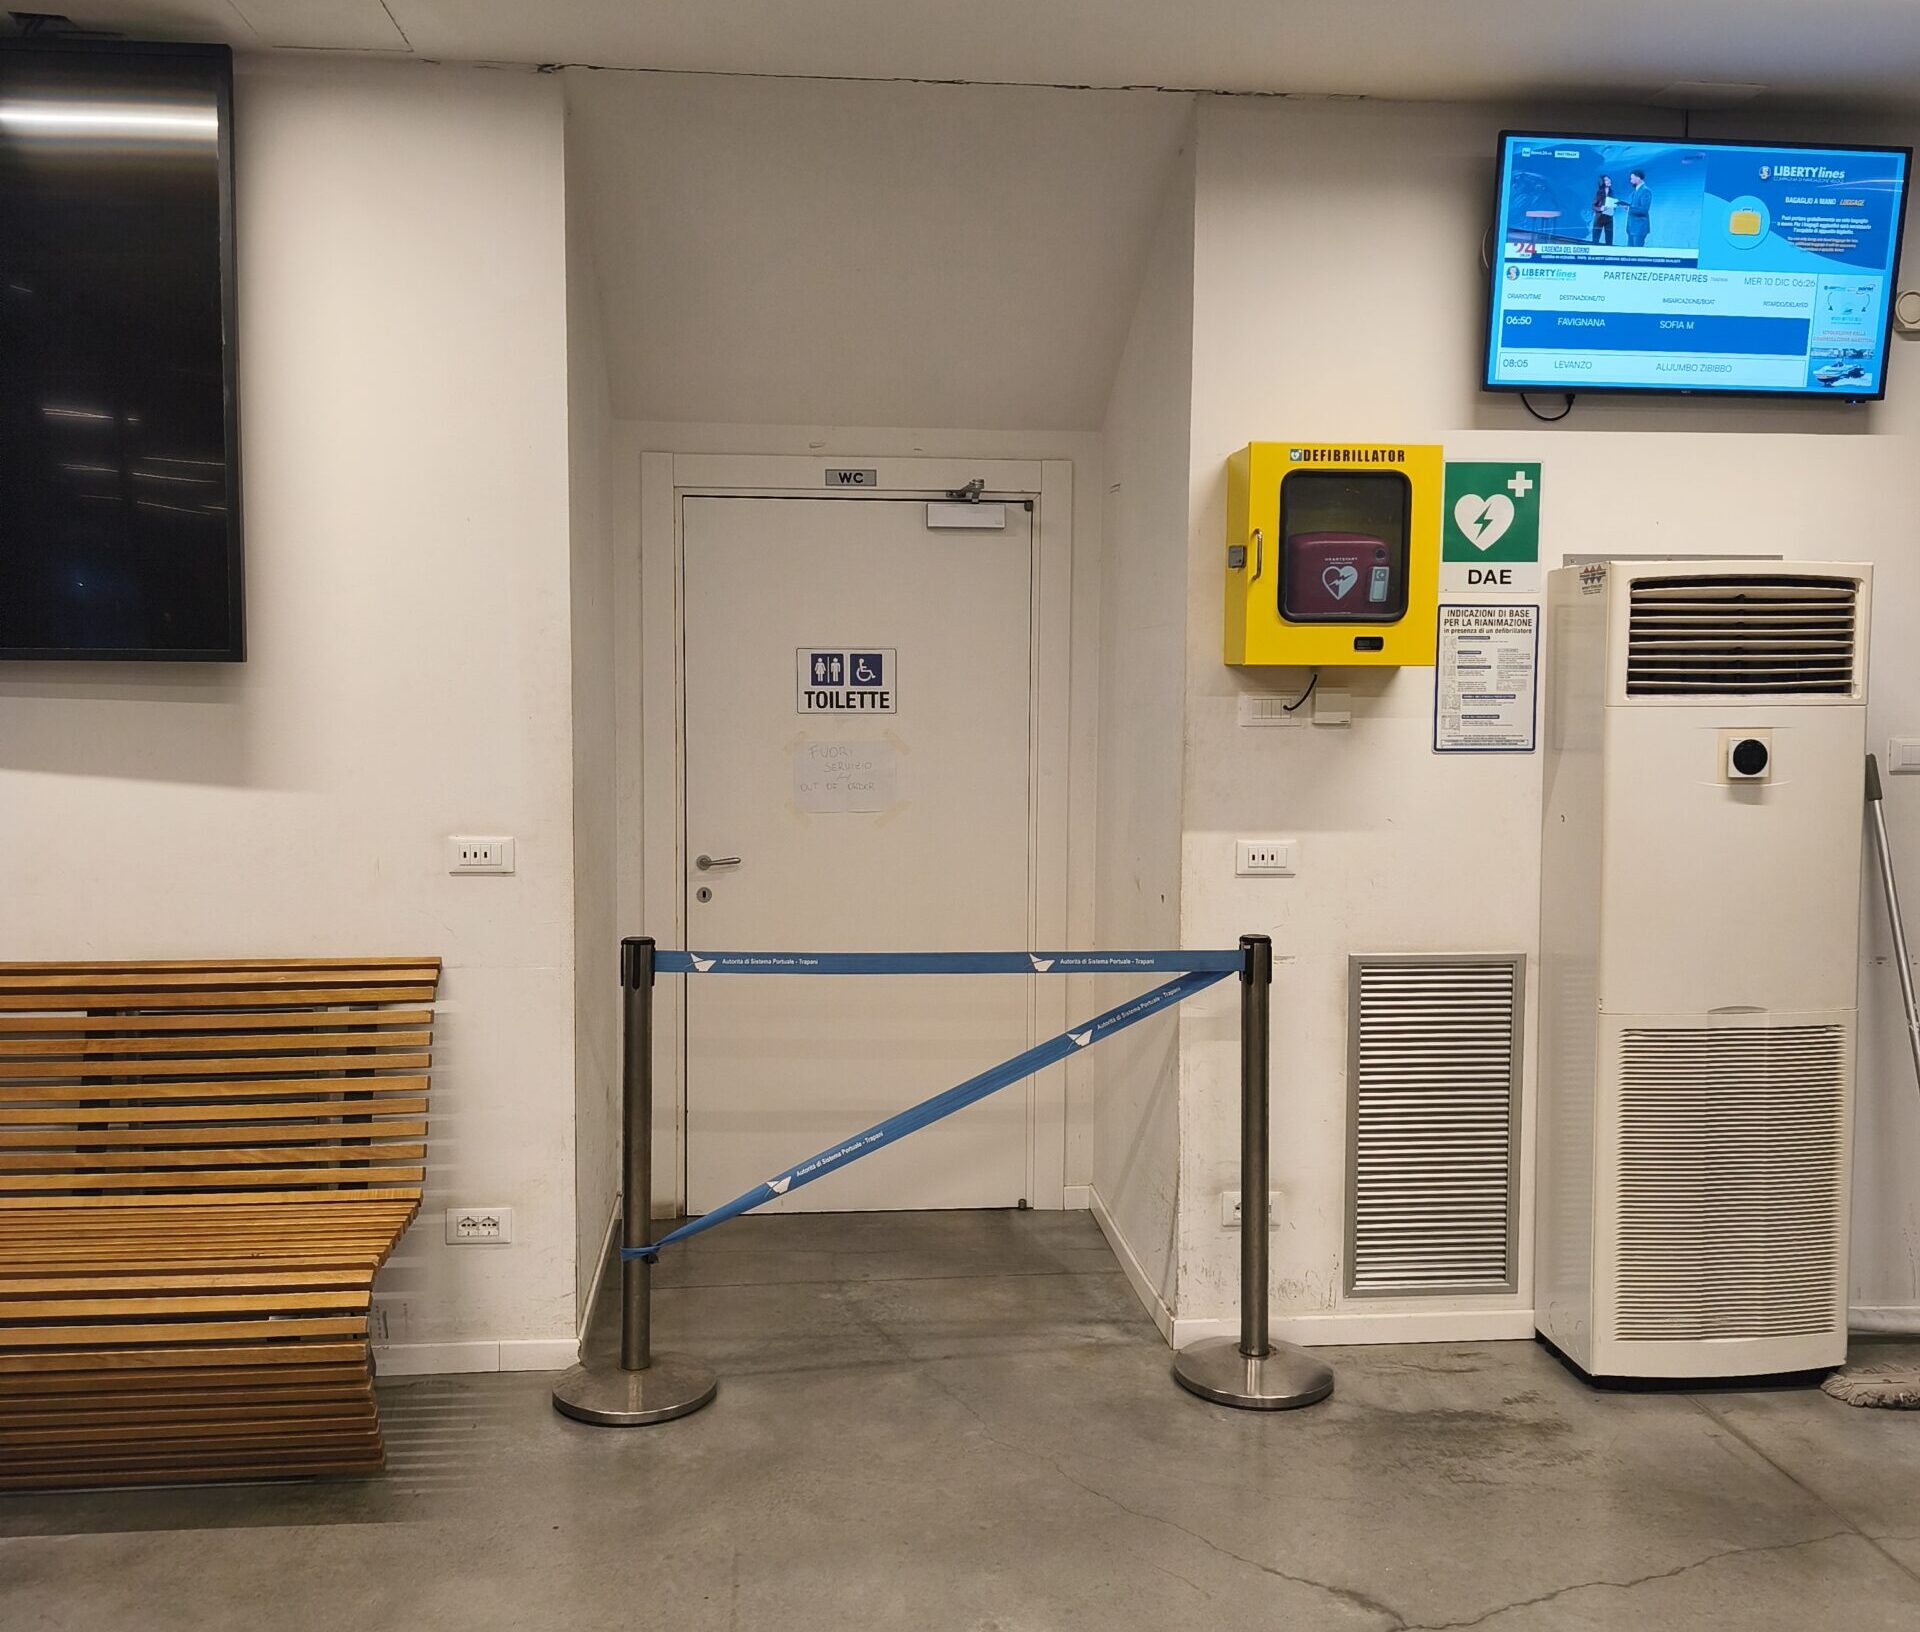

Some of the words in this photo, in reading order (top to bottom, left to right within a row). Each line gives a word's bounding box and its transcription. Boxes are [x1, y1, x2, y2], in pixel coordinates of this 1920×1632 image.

[1603, 271, 1708, 284] PARTENZE/DEPARTURES
[1744, 277, 1762, 286] MER
[1764, 278, 1773, 286] 10
[1775, 278, 1790, 287] DIC
[1792, 279, 1816, 288] 06:26
[1506, 316, 1532, 325] 06:50
[1557, 317, 1606, 327] FAVIGNANA
[1659, 320, 1685, 329] SOFIA
[1686, 321, 1694, 330] M
[1502, 359, 1529, 368] 08:05
[1554, 360, 1593, 370] LEVANZO
[1699, 363, 1733, 373] ZIBIBBO
[1302, 448, 1406, 463] DEFIBRILLATOR
[837, 471, 865, 484] WC
[1466, 569, 1513, 585] DAE
[1447, 609, 1496, 618] INDICAZIONI
[1498, 609, 1507, 618] DI
[1509, 609, 1530, 618] BASE
[1443, 618, 1460, 627] PER
[1462, 618, 1472, 627] LA
[1474, 618, 1533, 627] RIANIMAZIONE
[803, 690, 891, 710] TOILETTE
[799, 782, 819, 793] OUT
[826, 782, 839, 791] OF
[847, 782, 875, 791] ORDER
[799, 958, 818, 966] Trapani
[1135, 957, 1155, 966] Trapani
[1121, 1006, 1141, 1018] Sistema
[1140, 996, 1160, 1009] Portuale
[821, 1151, 842, 1165] Sistema
[841, 1141, 862, 1156] Portuale
[864, 1130, 884, 1144] Trapani
